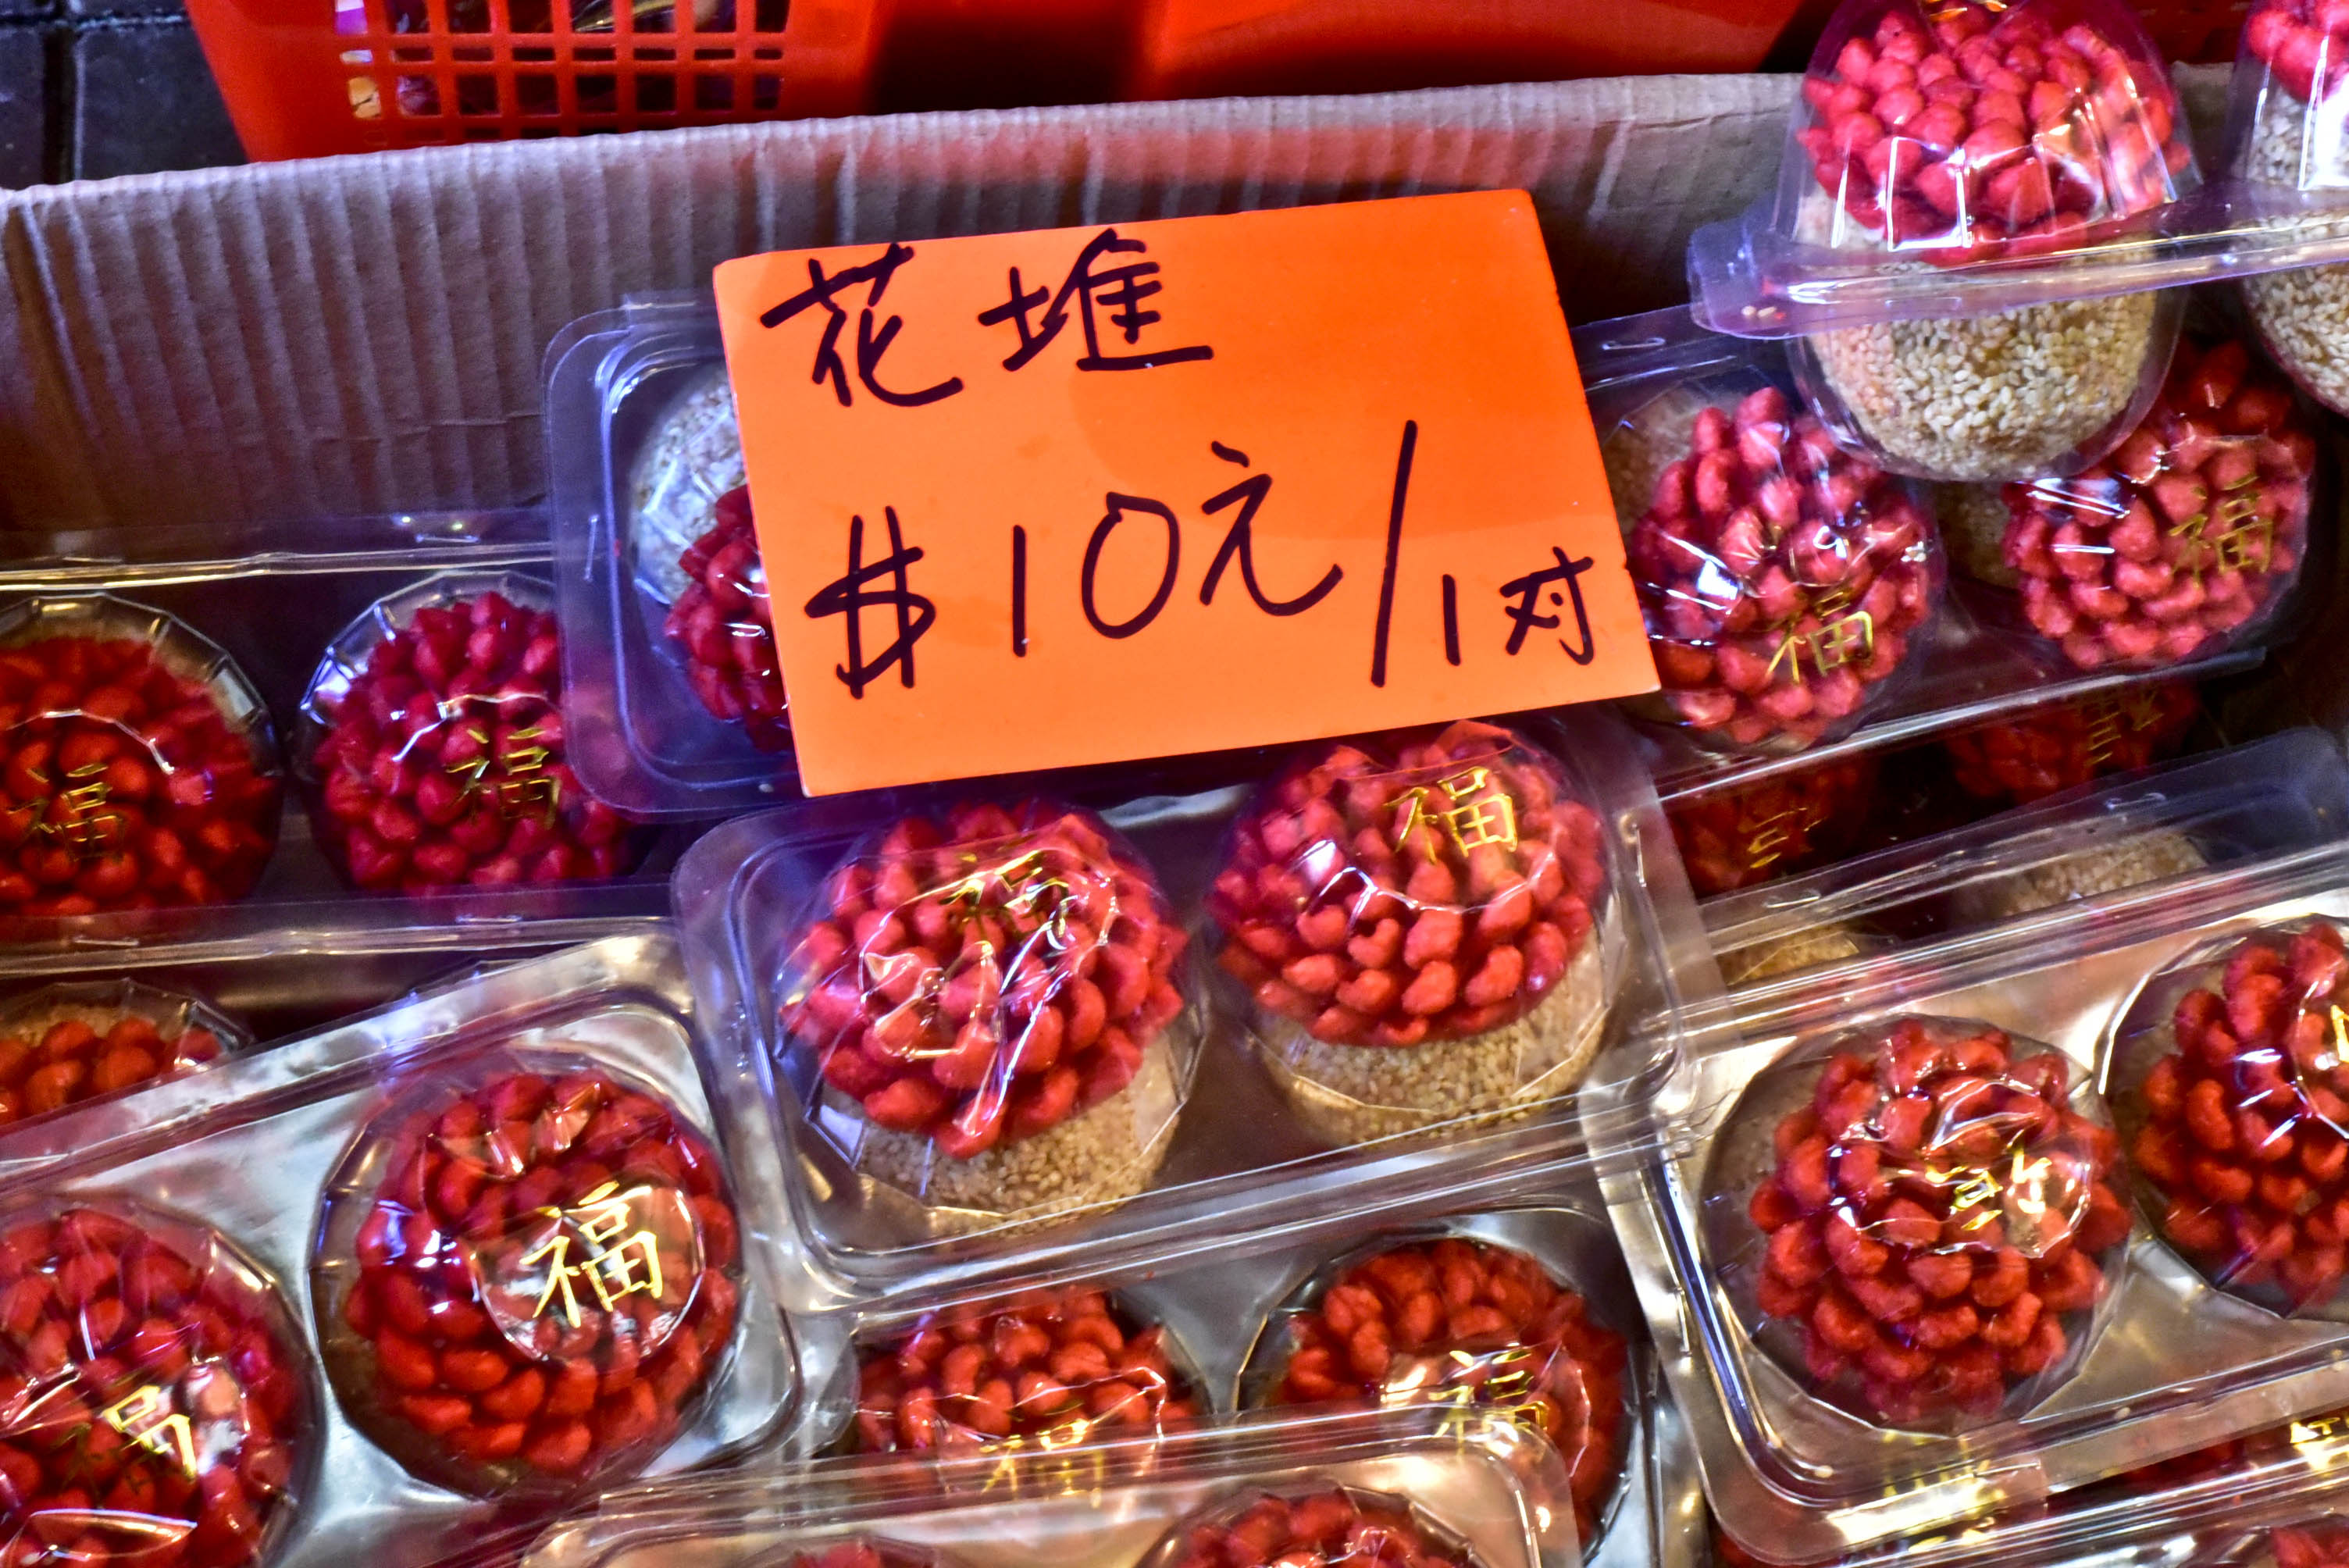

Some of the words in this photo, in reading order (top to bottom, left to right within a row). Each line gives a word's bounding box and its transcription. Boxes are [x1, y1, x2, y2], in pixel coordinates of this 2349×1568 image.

[761, 228, 1212, 407] 花堆
[2168, 475, 2274, 589] 福
[1763, 586, 1874, 686] 福
[6, 762, 127, 863] 福
[441, 727, 562, 831] 福
[1381, 765, 1518, 864] 福
[518, 1180, 663, 1328] 福
